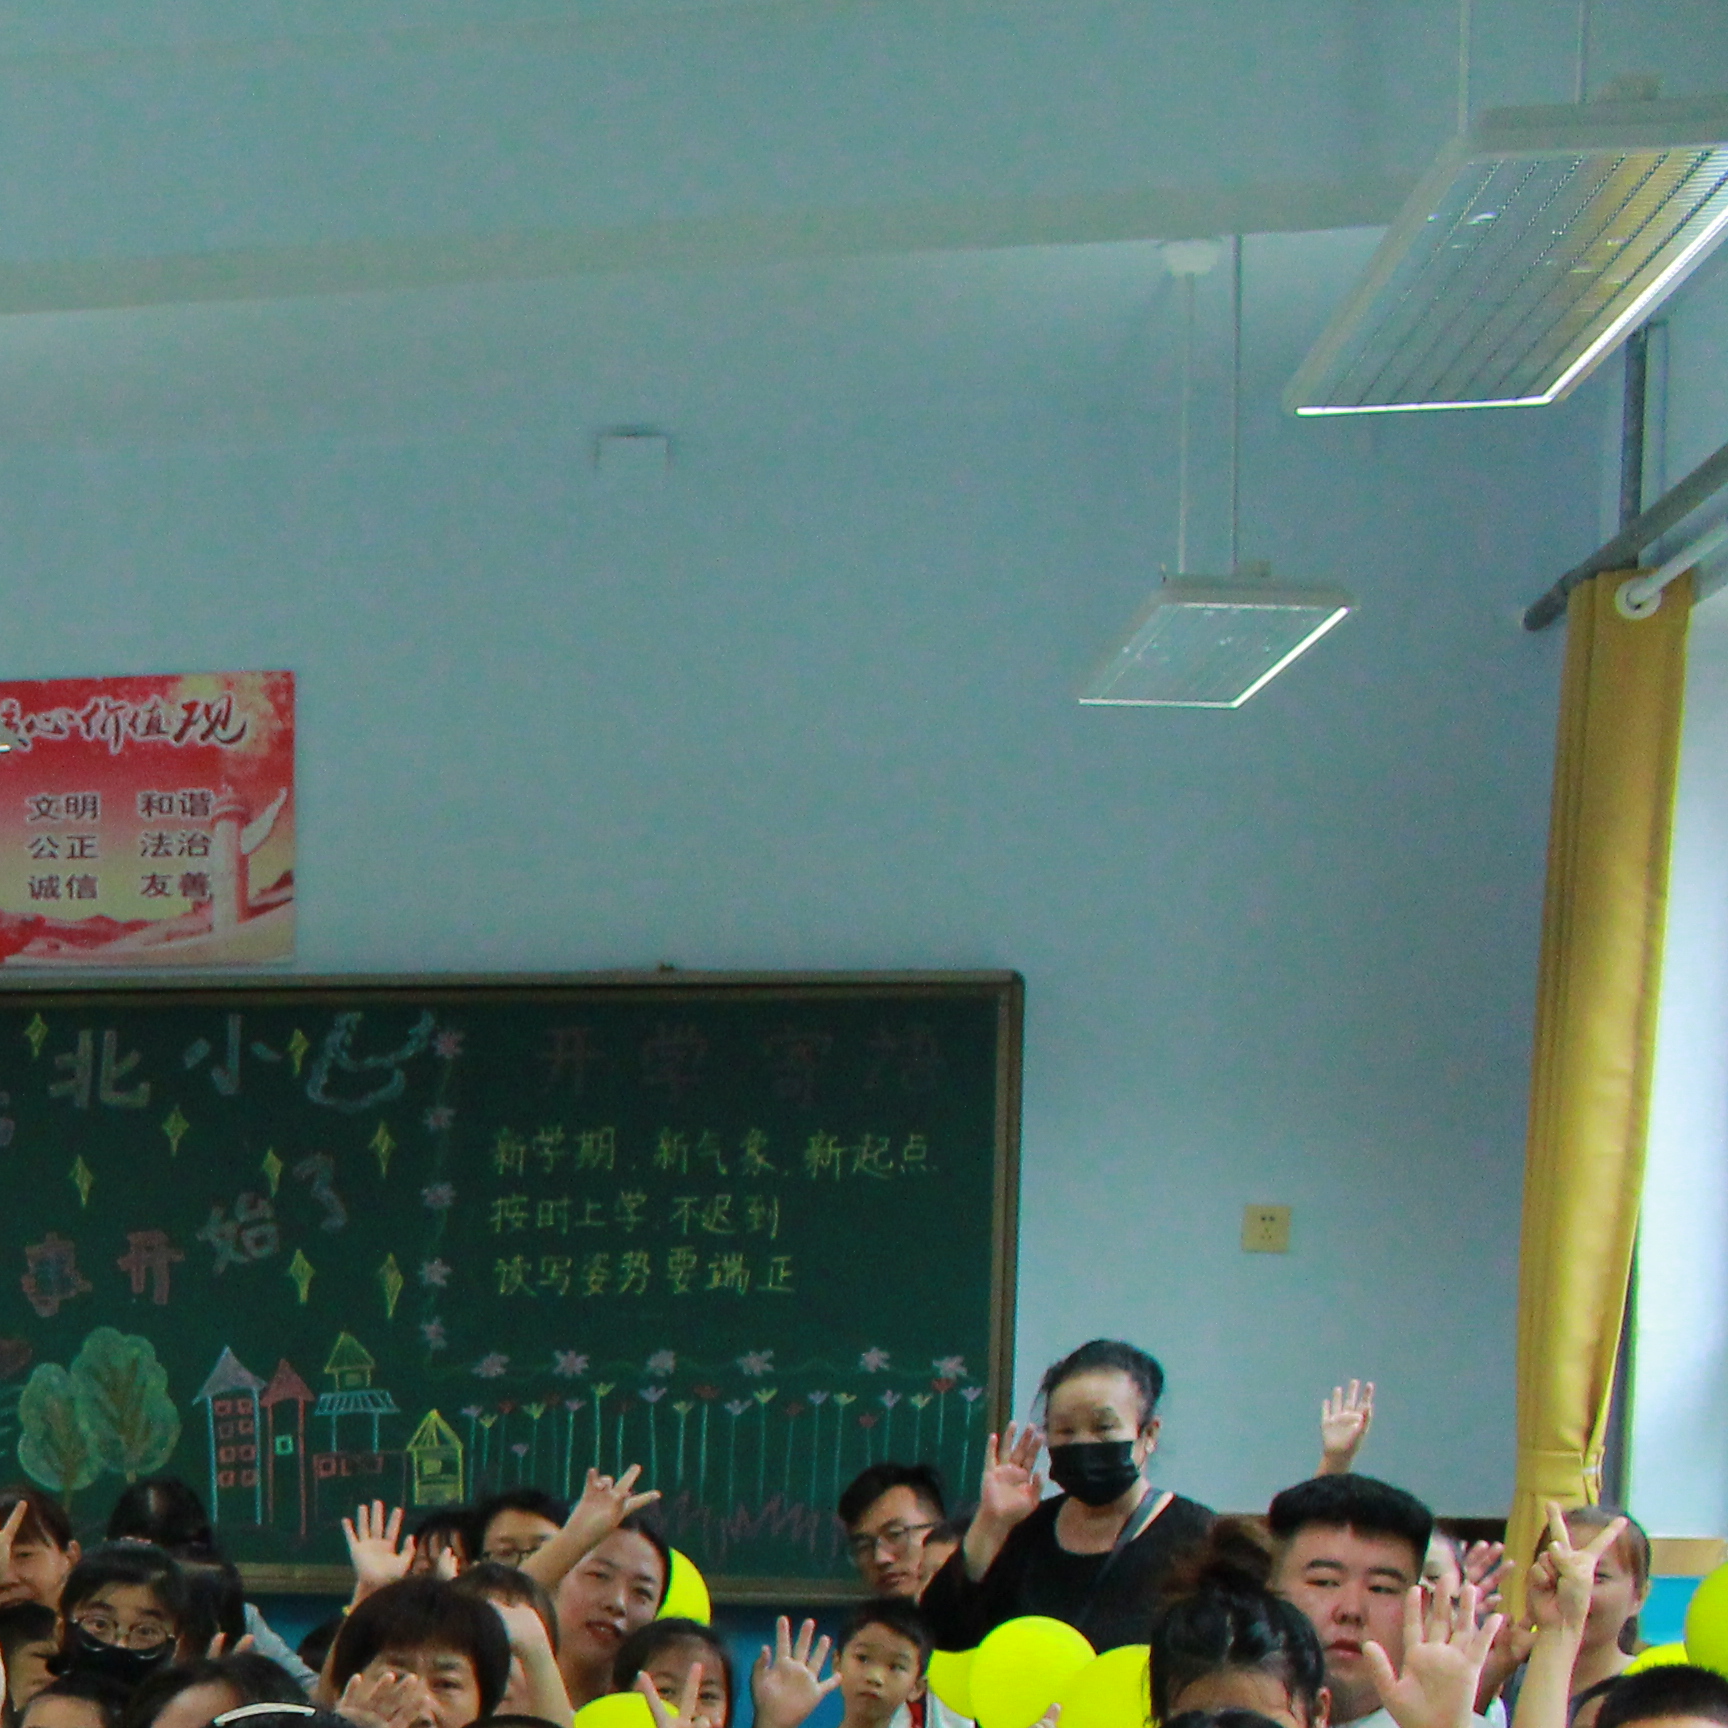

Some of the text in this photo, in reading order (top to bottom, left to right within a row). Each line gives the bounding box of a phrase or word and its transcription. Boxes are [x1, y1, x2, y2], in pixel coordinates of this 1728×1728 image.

[26, 794, 100, 823] 文明
[138, 790, 213, 819] 和谐
[26, 834, 100, 862] 公正
[138, 831, 211, 858] 法治
[27, 873, 99, 902] 诚信
[138, 871, 212, 900] 友善
[494, 1246, 795, 1297] 读写姿势要端正
